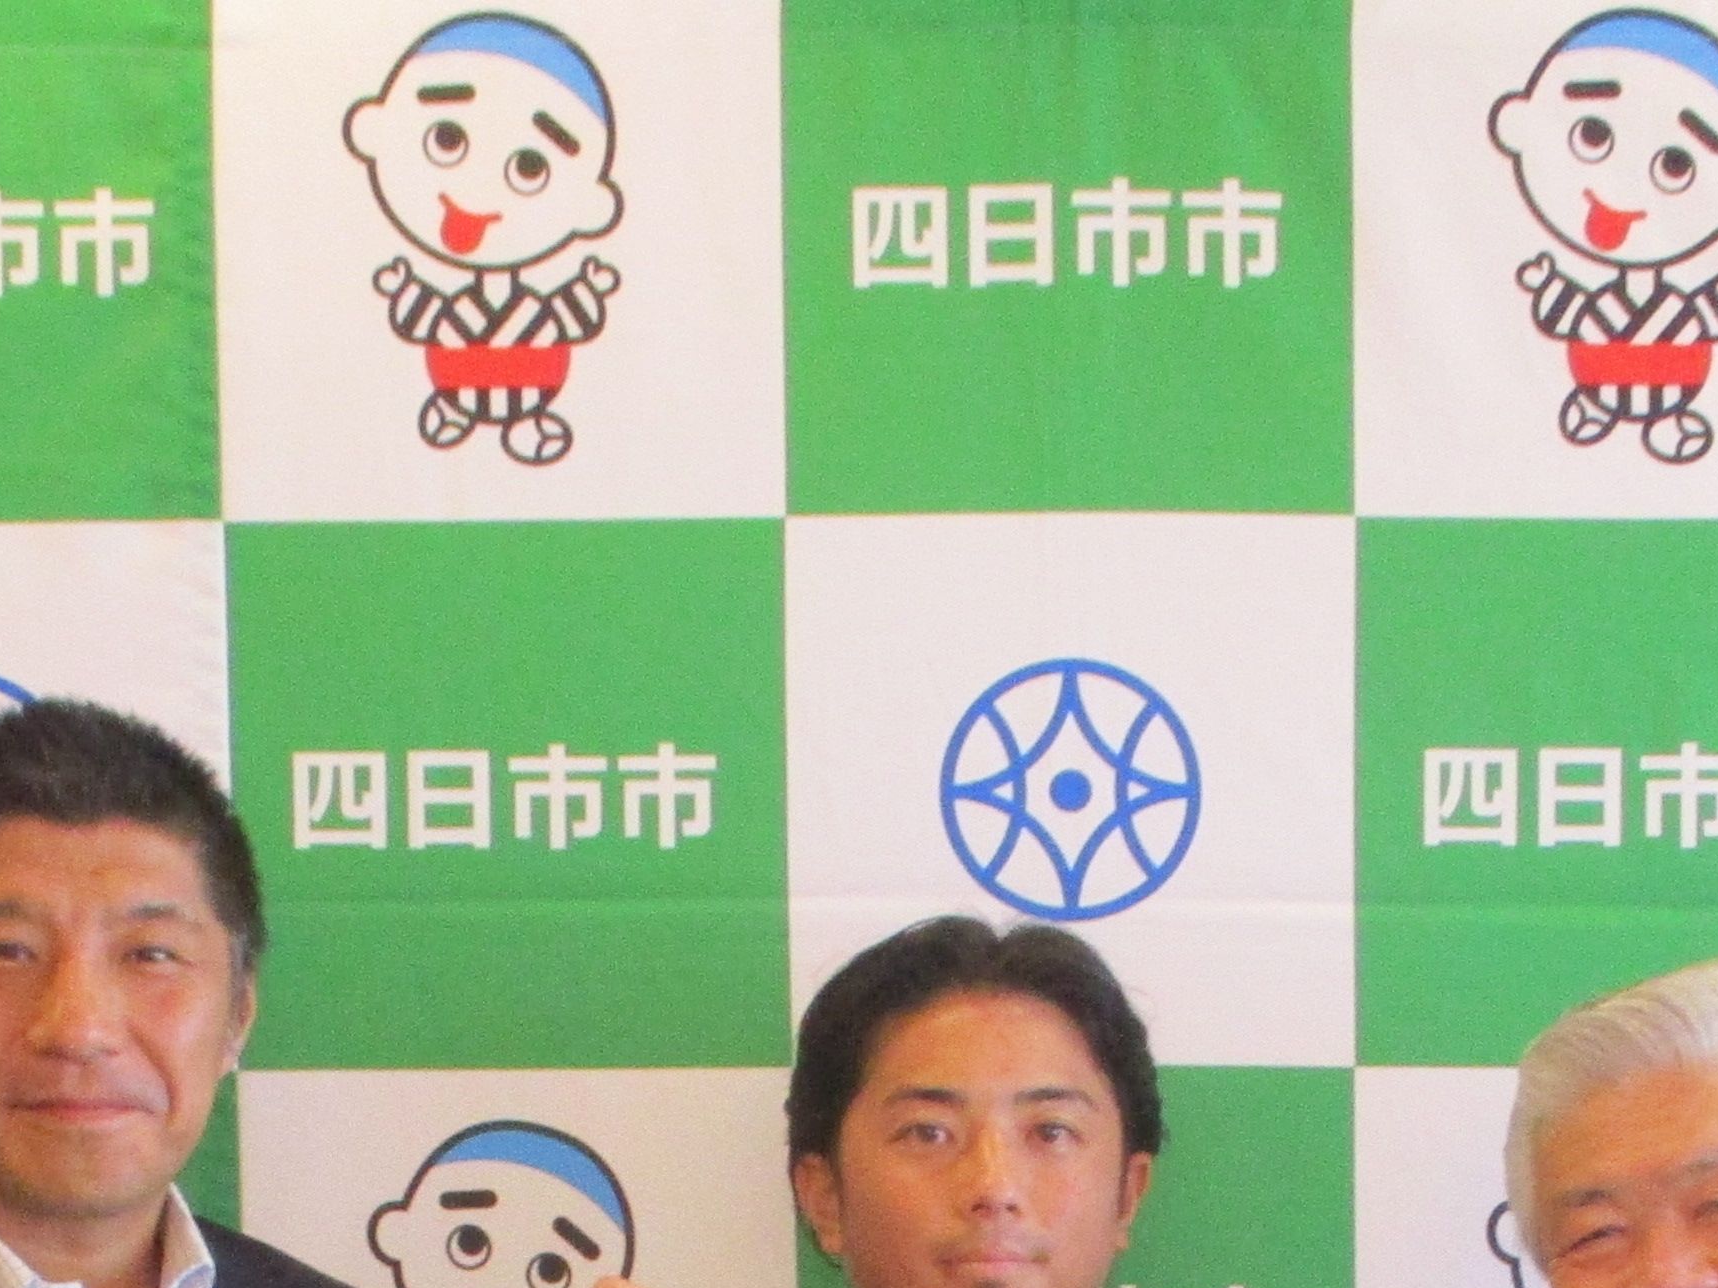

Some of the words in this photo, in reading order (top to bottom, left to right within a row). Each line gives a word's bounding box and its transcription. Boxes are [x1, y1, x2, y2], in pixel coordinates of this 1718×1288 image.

[852, 176, 1282, 288] 四日市市
[292, 742, 717, 849] 四日市市
